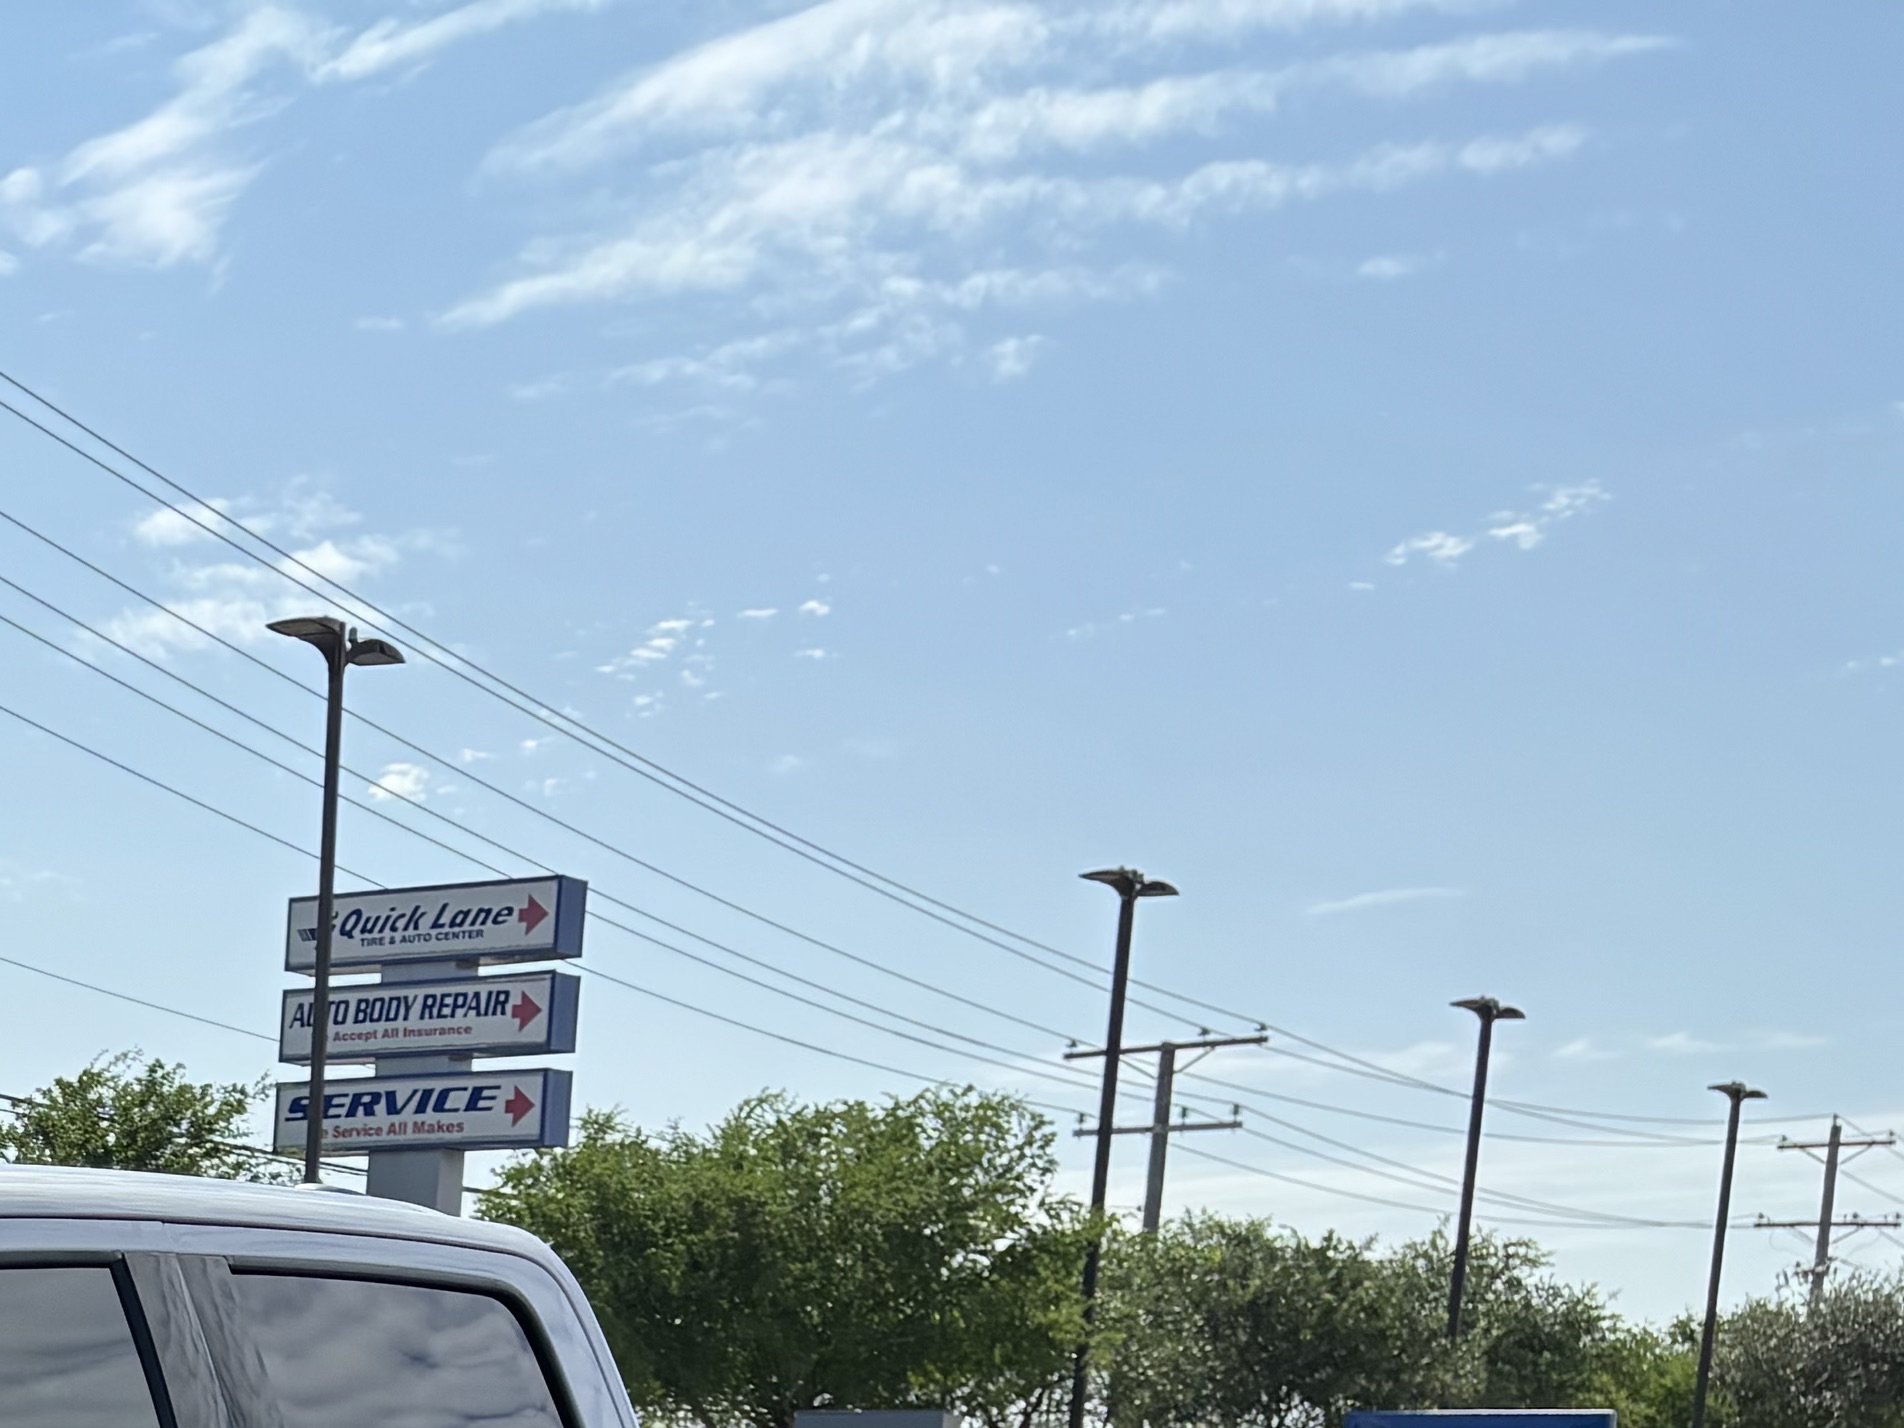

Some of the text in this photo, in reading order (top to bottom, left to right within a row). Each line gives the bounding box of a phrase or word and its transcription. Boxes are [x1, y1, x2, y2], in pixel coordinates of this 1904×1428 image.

[339, 902, 515, 939] Quick Lane
[360, 937, 386, 948] TIRE
[399, 932, 432, 945] AUTO
[435, 928, 484, 941] CENTER
[352, 994, 418, 1025] BODY
[419, 989, 511, 1021] REPAIR
[333, 1030, 378, 1043] Accept
[382, 1028, 400, 1039] All
[403, 1025, 473, 1039] Insurance
[284, 1084, 502, 1122] SERVICE
[332, 1125, 383, 1139] Service
[387, 1122, 408, 1136] All
[412, 1118, 465, 1134] Makes
